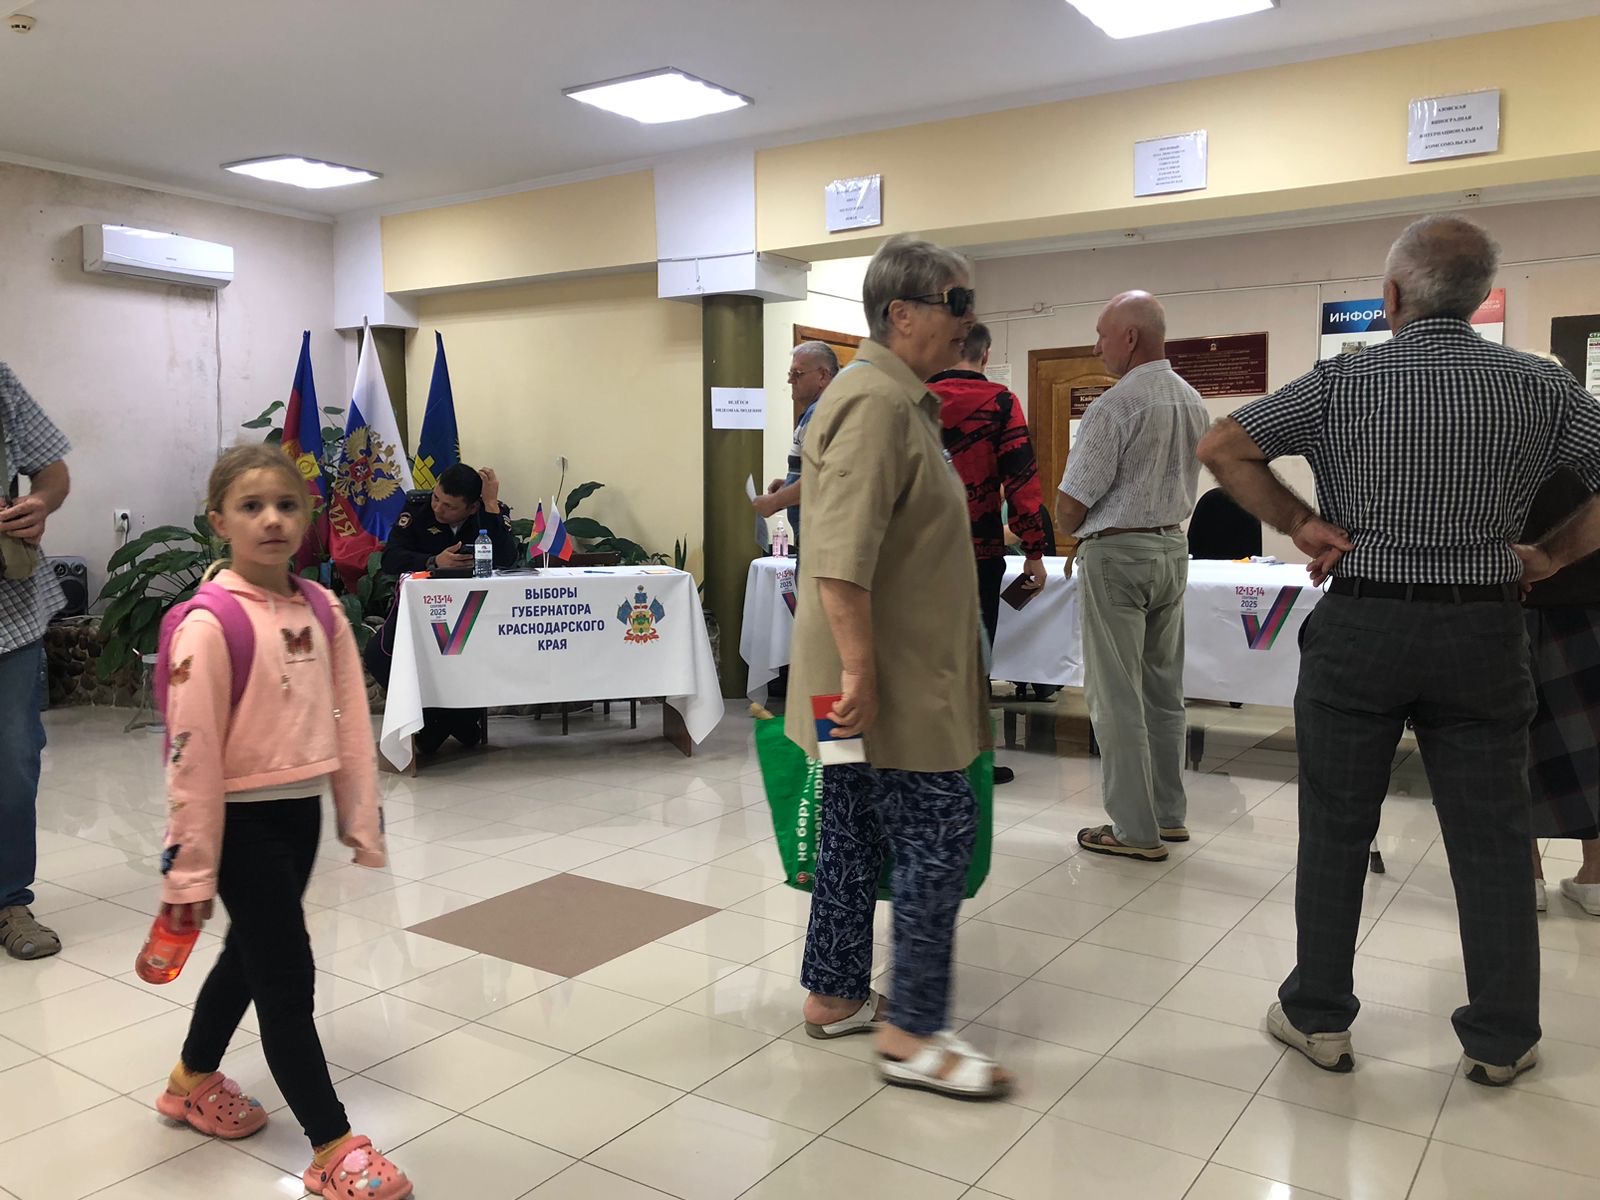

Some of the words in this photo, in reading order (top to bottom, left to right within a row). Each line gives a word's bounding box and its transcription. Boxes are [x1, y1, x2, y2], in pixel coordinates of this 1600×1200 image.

[525, 587, 577, 600] ВЫБОРЫ
[511, 603, 591, 617] ГУБЕРНАТОРА
[1241, 600, 1258, 608] 2025
[430, 608, 447, 616] 2025
[498, 619, 605, 636] КРАСНОДАРСКОГО
[538, 638, 568, 651] КРАЯ
[796, 798, 809, 837] беру
[798, 841, 807, 860] не
